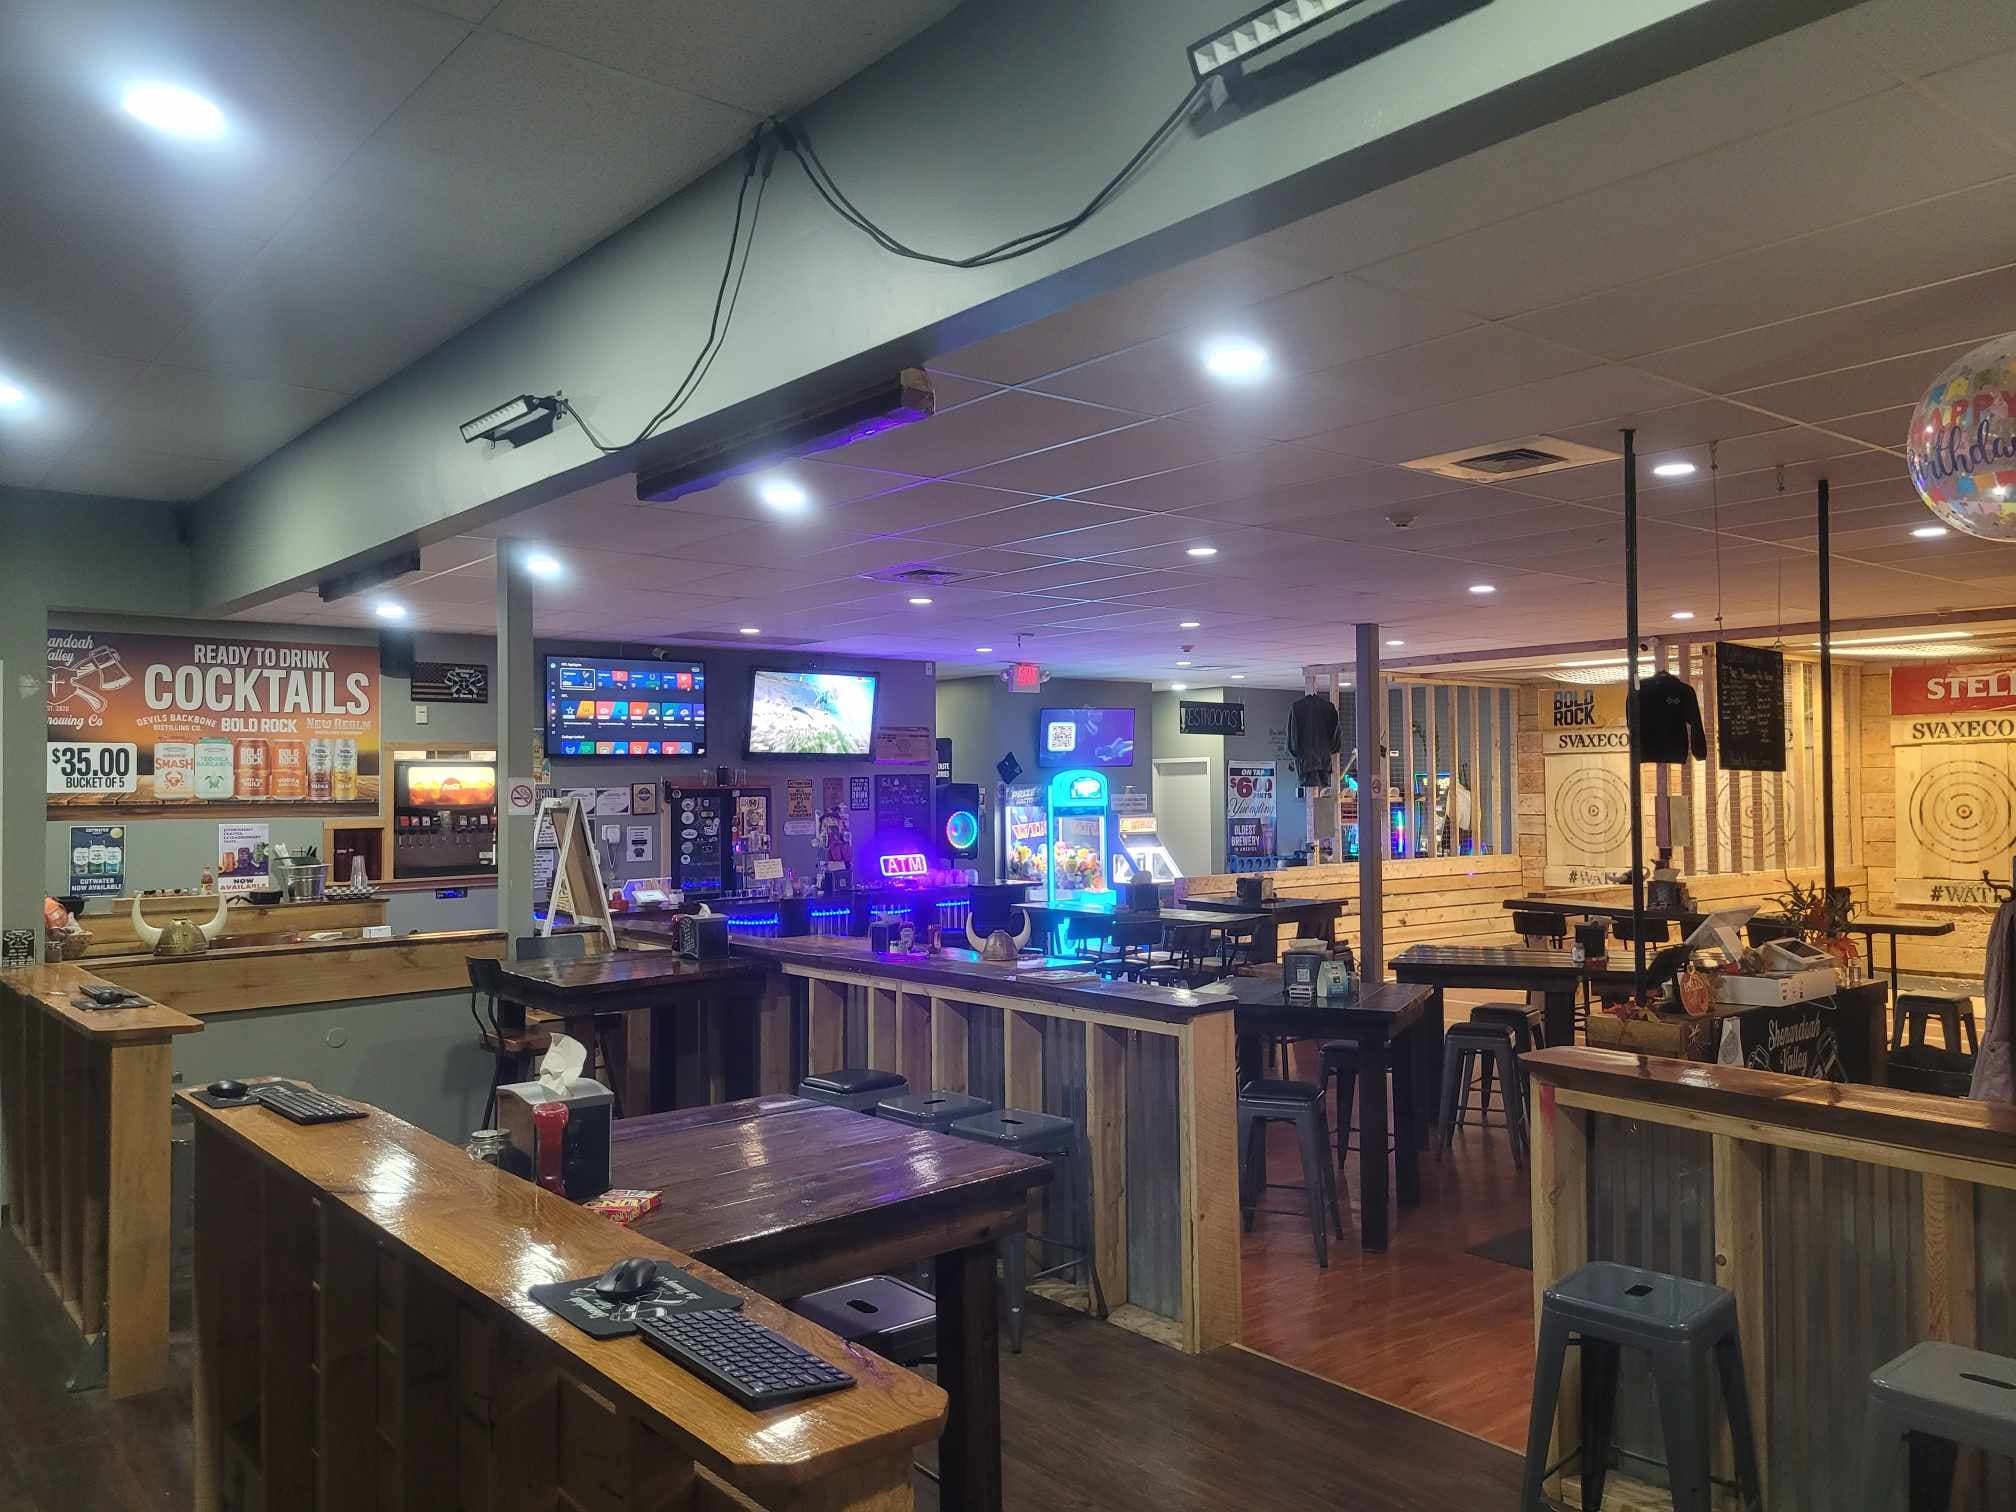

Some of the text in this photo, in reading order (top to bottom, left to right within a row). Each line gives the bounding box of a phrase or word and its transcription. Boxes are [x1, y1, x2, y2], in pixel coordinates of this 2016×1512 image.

[48, 634, 93, 649] andoah
[48, 648, 74, 666] alley
[194, 643, 329, 669] READY TO DRINK
[145, 663, 370, 716] COCKTAILS
[1553, 689, 1594, 711] BOLD
[88, 714, 103, 727] Co
[137, 714, 217, 728] DEVILS BACKBONE
[1553, 705, 1595, 727] ROCK
[221, 717, 258, 732] BOLD
[261, 719, 297, 733] ROCK
[1912, 719, 2015, 740] SVAXECO
[52, 747, 130, 777] $35.00
[155, 757, 194, 770] SMASH
[65, 776, 125, 788] BUCKET OF 5
[1234, 824, 1256, 835] OLDEST
[1231, 835, 1260, 847] BREWERY
[886, 856, 923, 873] ATM
[80, 877, 115, 885] CUTWATER
[88, 883, 122, 891] AVAILABLE
[1768, 1011, 1821, 1051] Shenandoah
[1783, 1045, 1808, 1076] Valley
